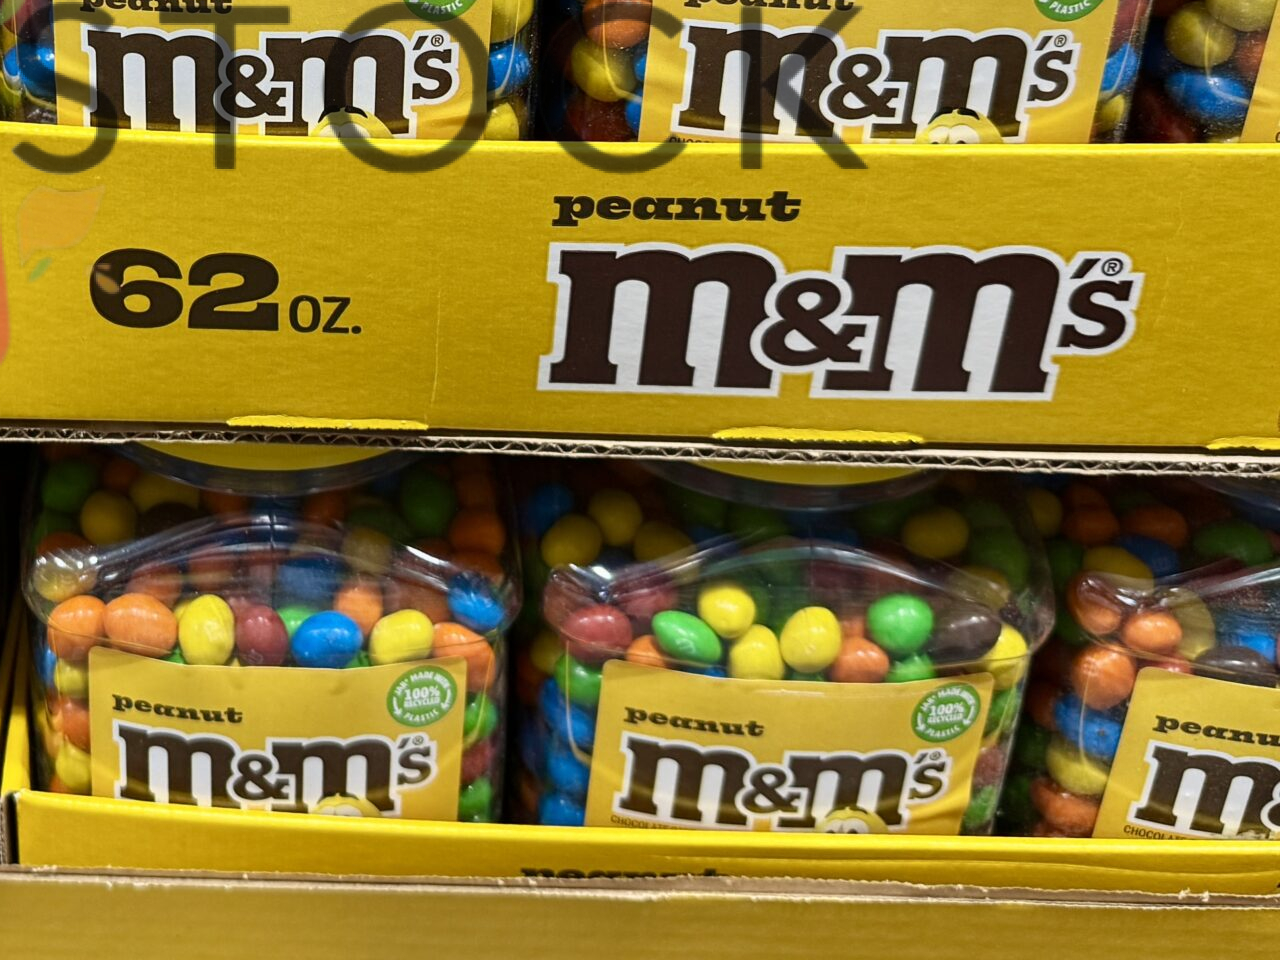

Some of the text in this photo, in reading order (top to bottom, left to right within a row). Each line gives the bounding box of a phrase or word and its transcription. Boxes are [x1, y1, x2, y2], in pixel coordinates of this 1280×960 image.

[86, 29, 453, 137] m&m's
[678, 25, 1073, 140] m&m's
[552, 190, 802, 227] peanut
[89, 248, 279, 331] 62
[549, 249, 1134, 393] m&m's
[404, 685, 441, 700] 100%
[410, 671, 434, 683] MADE
[113, 694, 243, 724] peanut
[404, 708, 439, 723] PLASTIC
[625, 707, 764, 737] peanut
[929, 702, 965, 716] 100%
[1152, 714, 1280, 747] peanu
[118, 725, 432, 812] m&m's
[618, 736, 945, 827] m&m's
